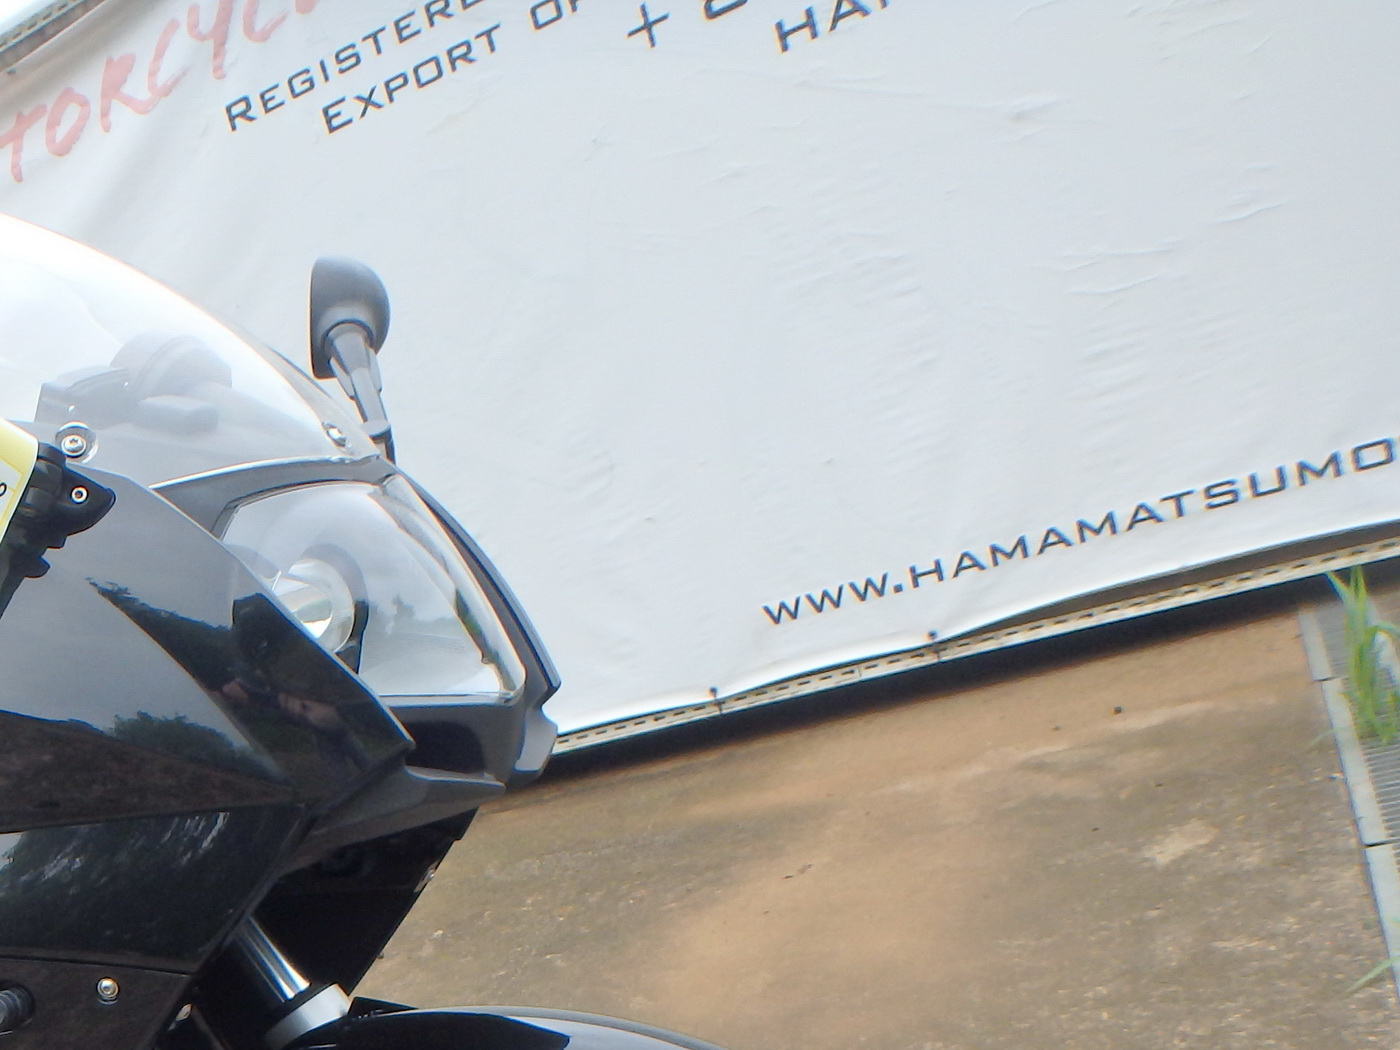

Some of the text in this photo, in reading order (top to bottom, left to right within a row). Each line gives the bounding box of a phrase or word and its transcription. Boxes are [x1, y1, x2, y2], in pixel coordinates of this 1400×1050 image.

[225, 0, 486, 132] REGISTER
[321, 0, 579, 135] EXPORT O
[774, 0, 890, 54] HA
